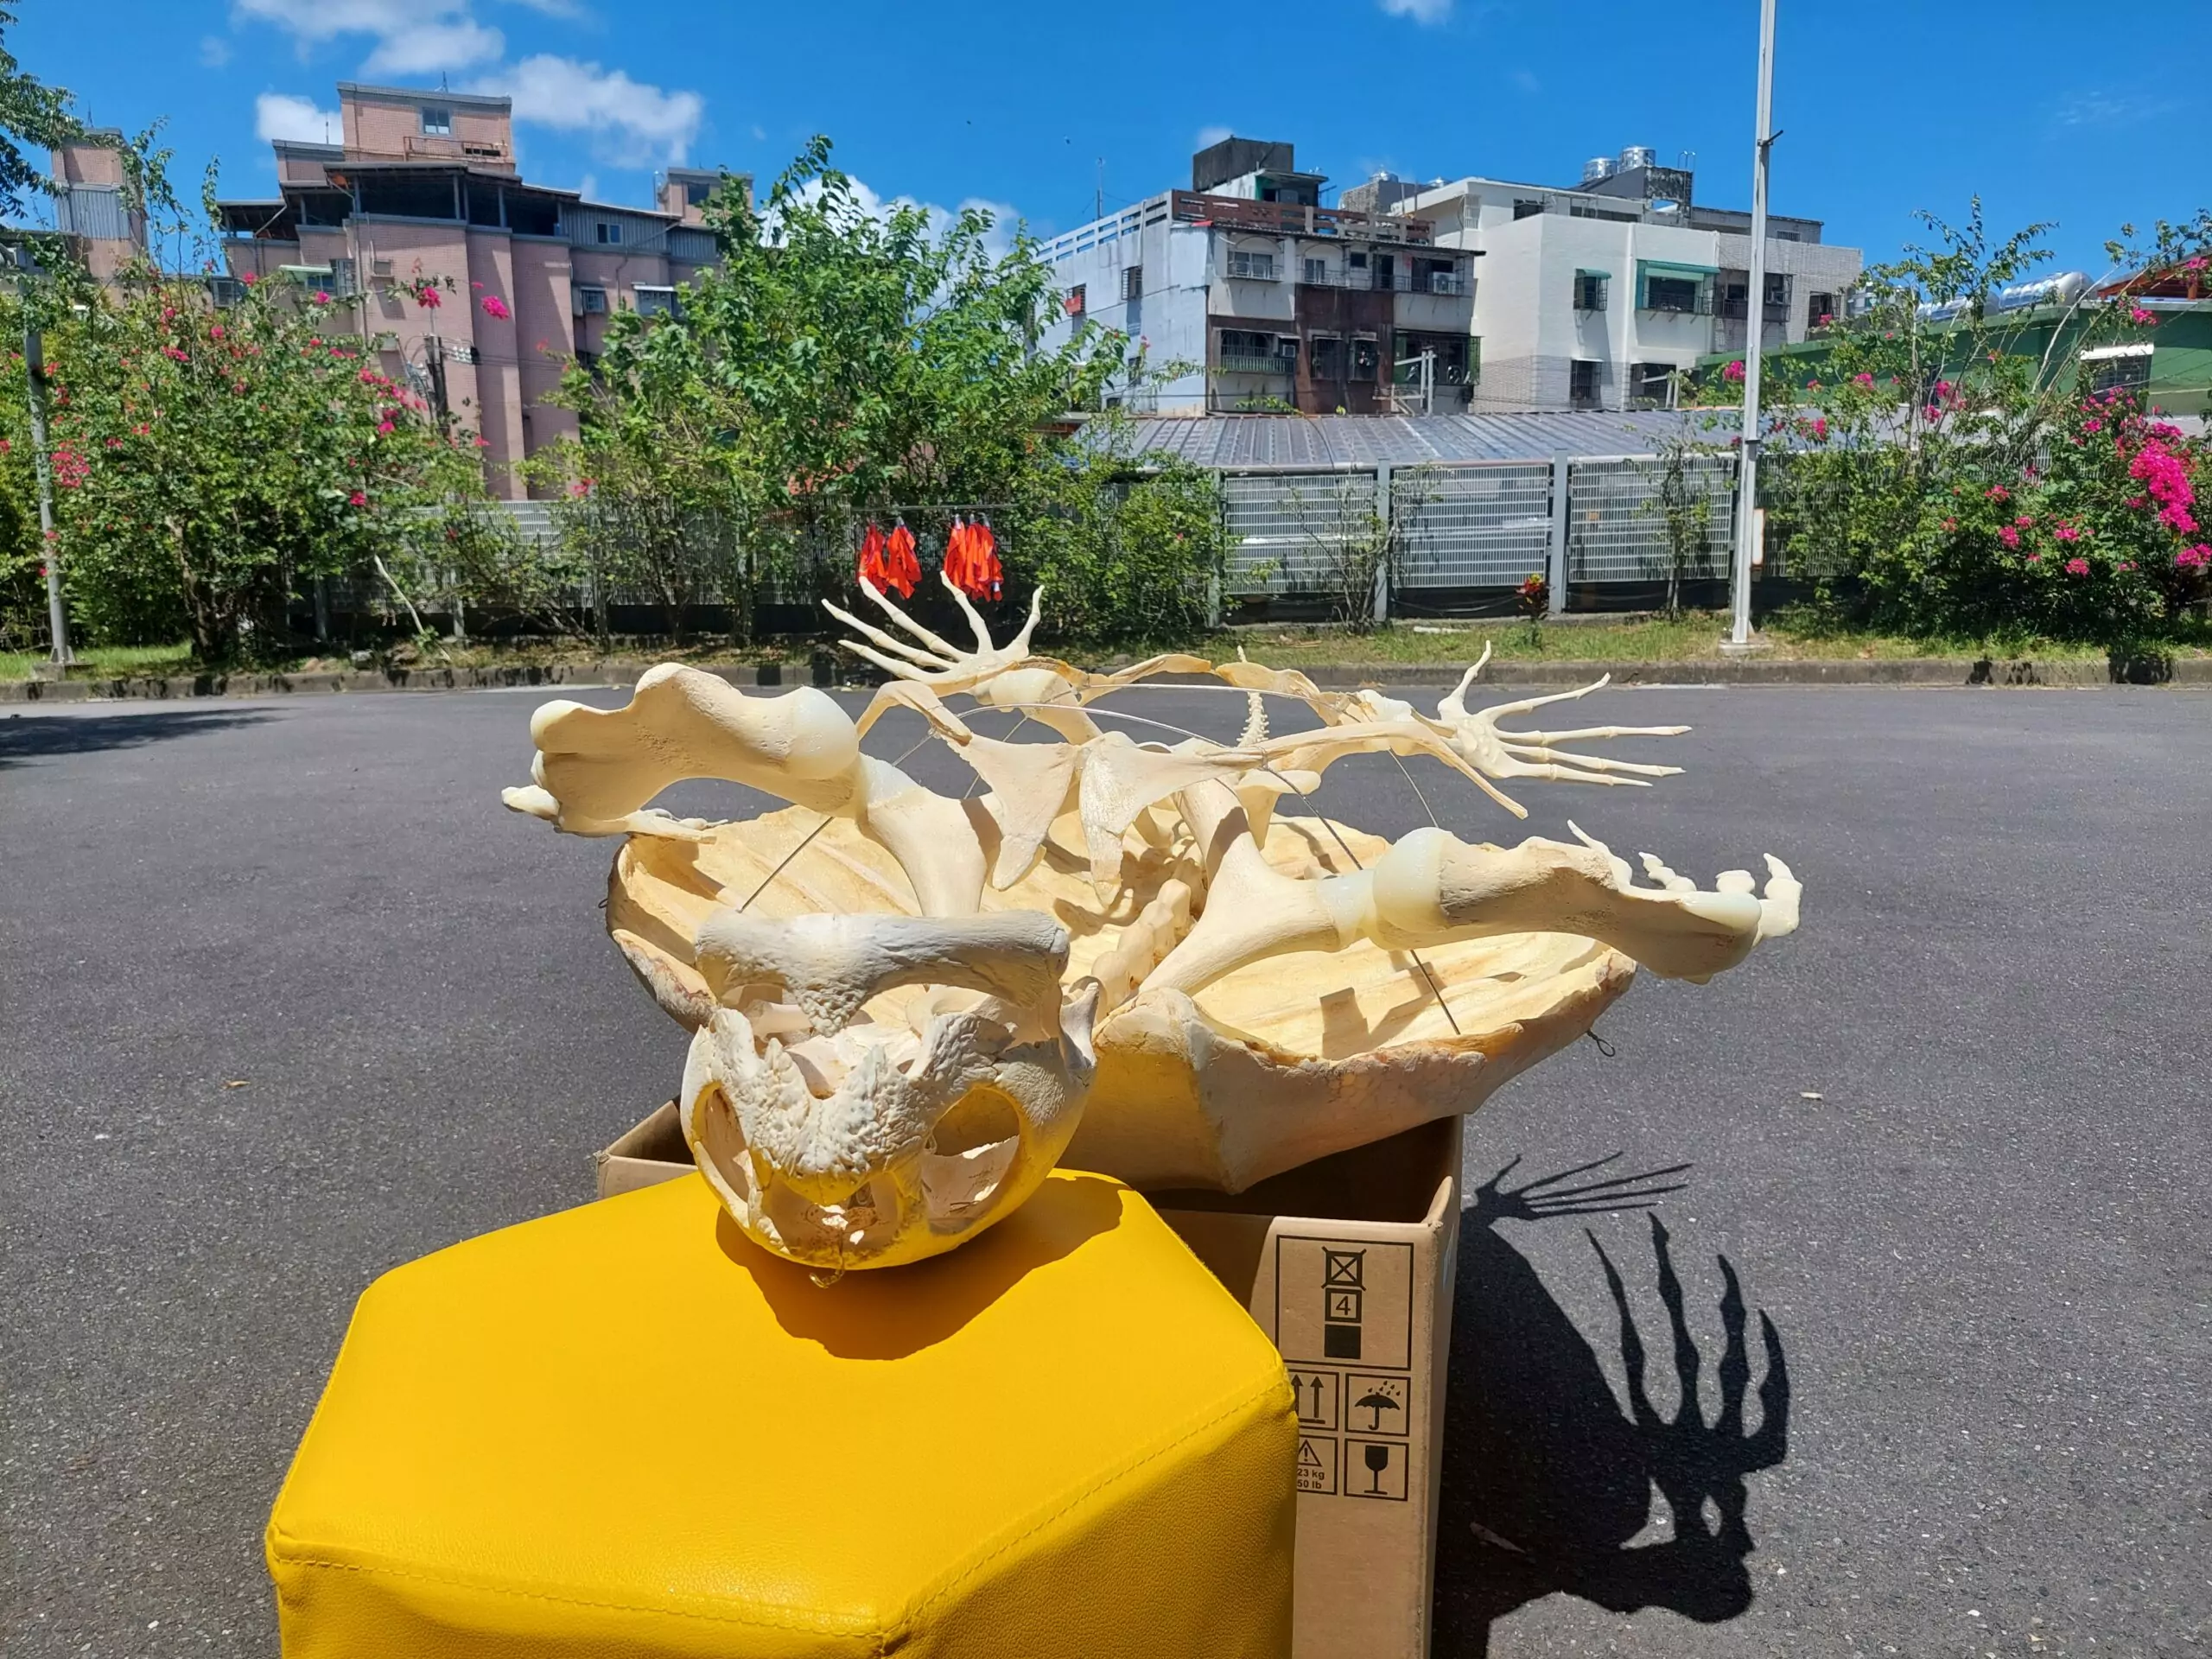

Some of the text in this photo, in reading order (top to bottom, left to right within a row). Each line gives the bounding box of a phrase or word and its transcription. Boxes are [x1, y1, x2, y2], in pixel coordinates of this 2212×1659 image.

[1335, 1295, 1351, 1315] 4
[1297, 1468, 1325, 1480] 23 kg
[1297, 1479, 1309, 1488] 50
